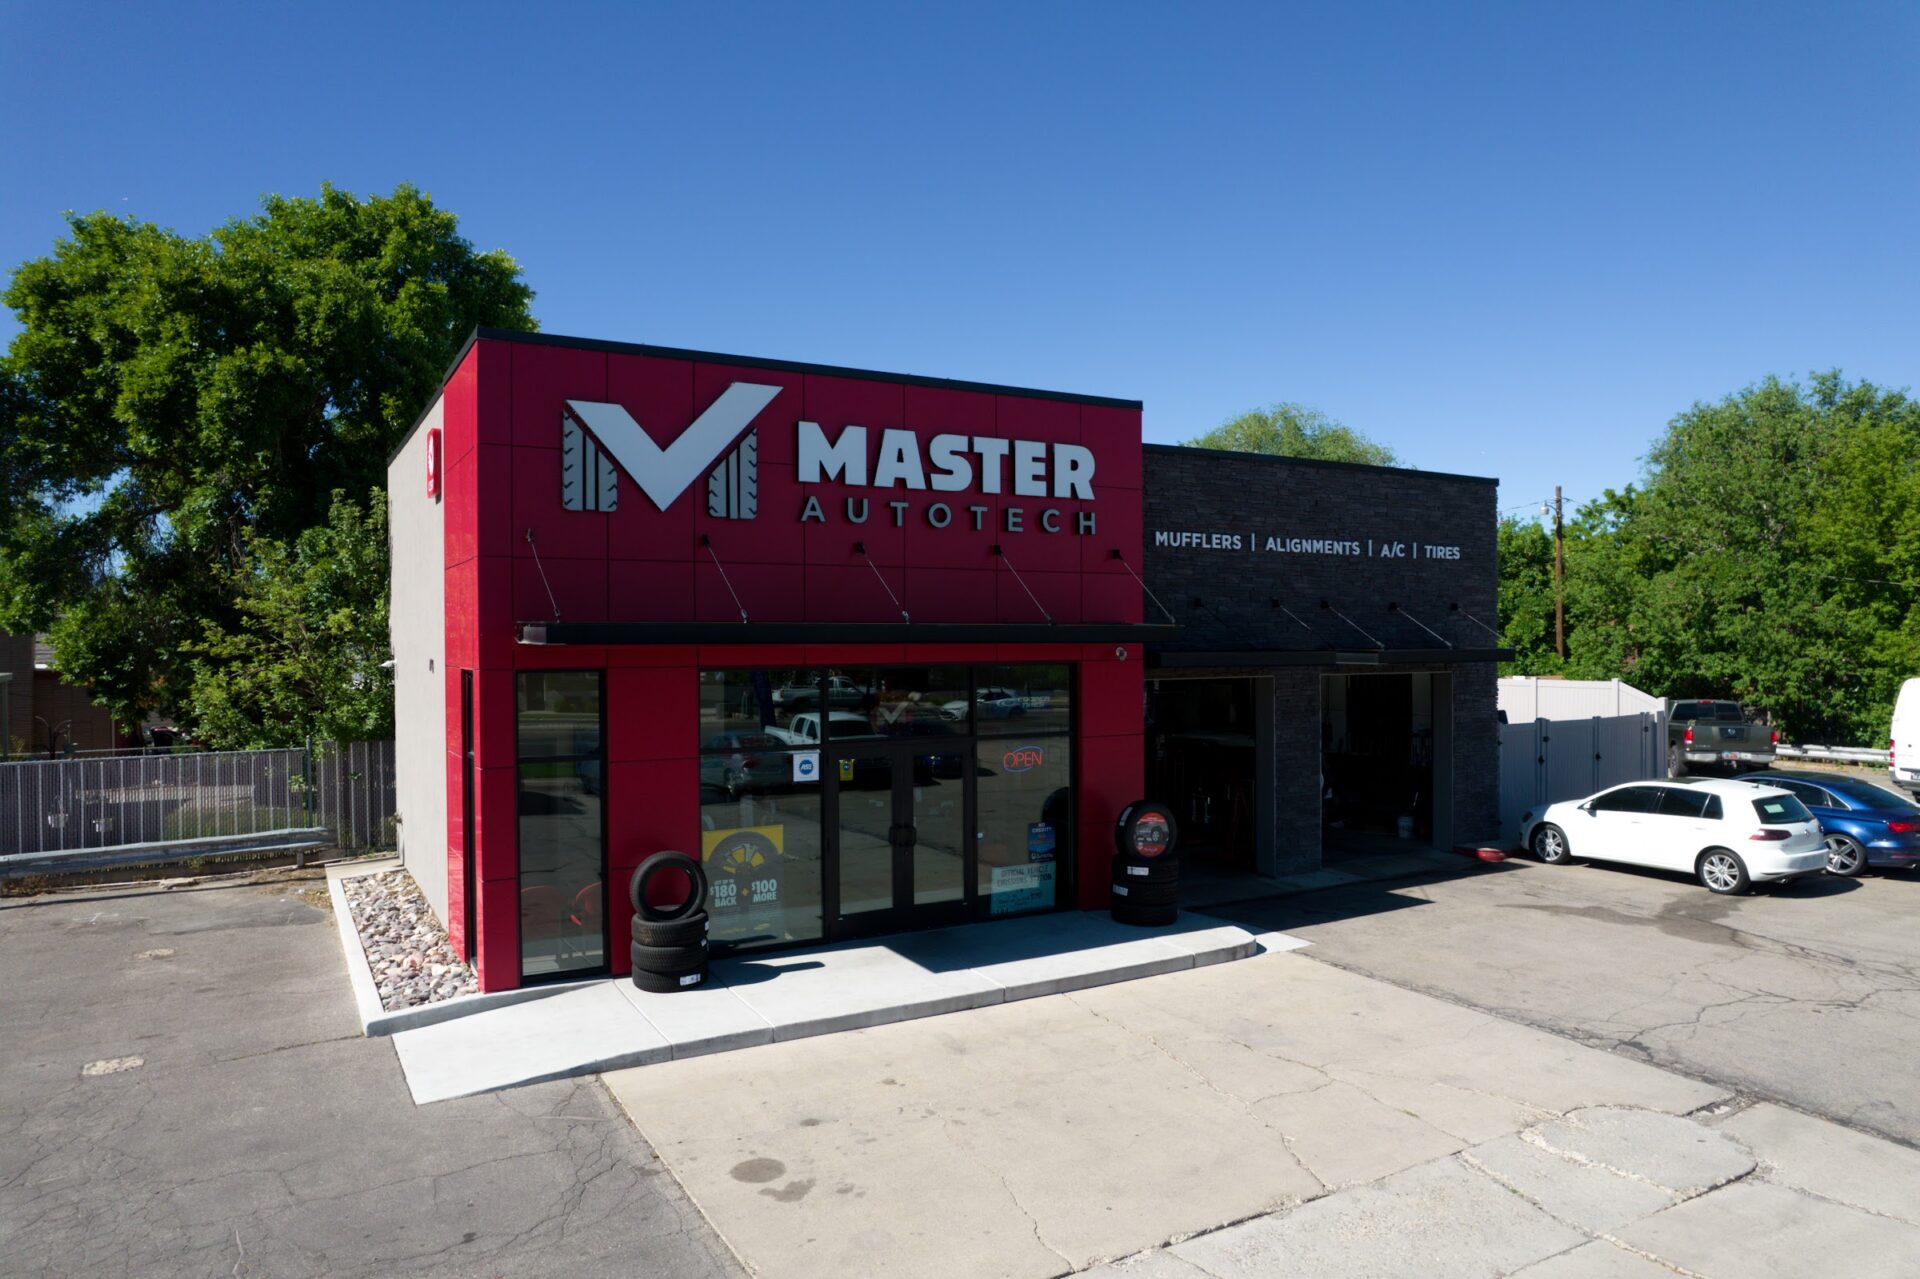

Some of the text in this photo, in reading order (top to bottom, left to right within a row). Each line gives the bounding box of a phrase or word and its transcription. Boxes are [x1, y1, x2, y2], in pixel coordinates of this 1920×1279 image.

[797, 420, 1096, 500] MASTER
[800, 496, 1097, 536] AUTOTECH
[1155, 531, 1460, 559] MUFFLERS ALIGNMENTS A/C TIRES
[1003, 751, 1042, 768] OPEN
[709, 884, 737, 898] $180
[751, 879, 778, 893] $100
[714, 896, 737, 908] BACK
[752, 891, 777, 903] MORE
